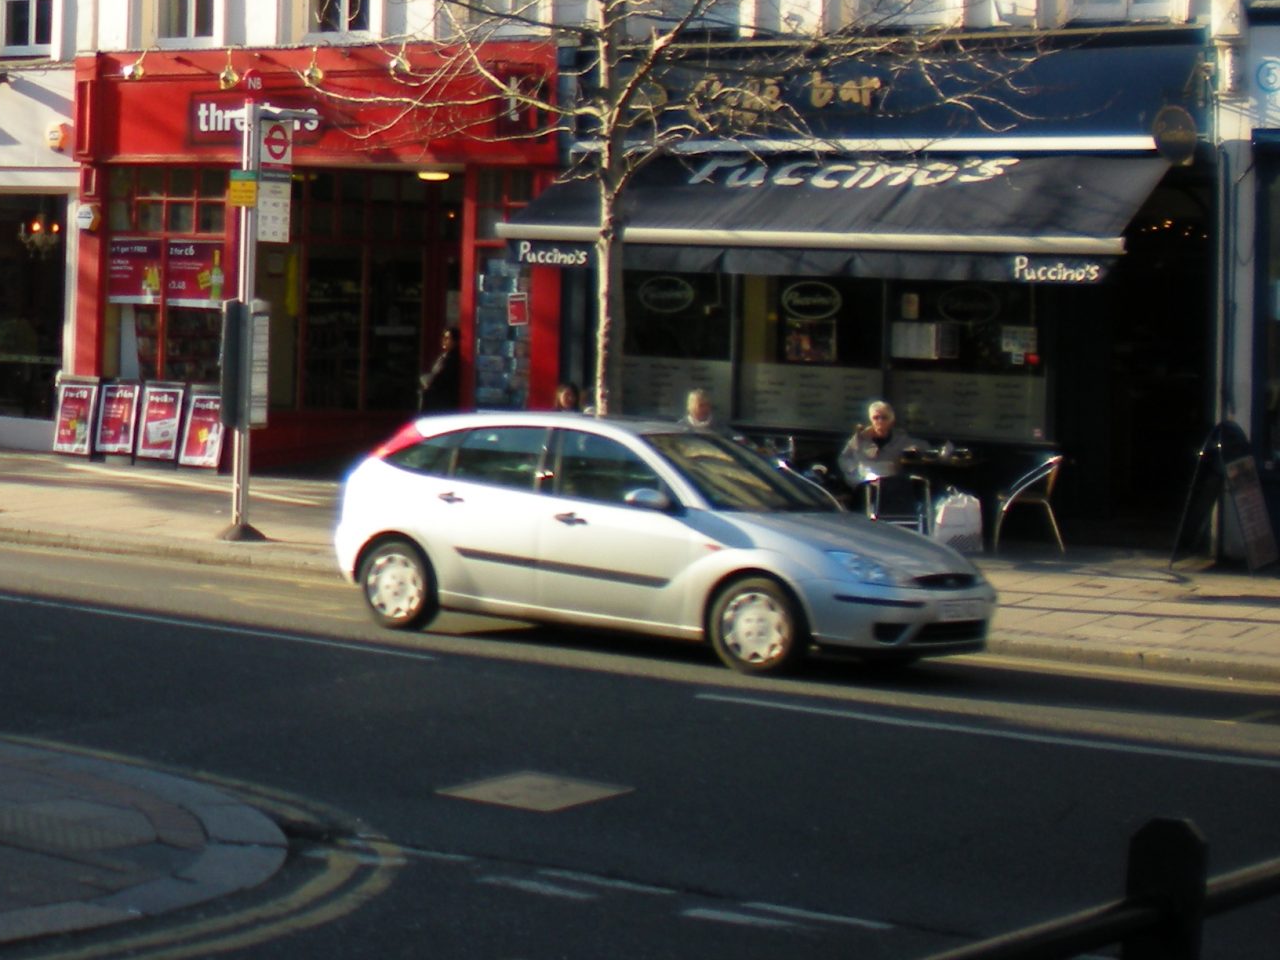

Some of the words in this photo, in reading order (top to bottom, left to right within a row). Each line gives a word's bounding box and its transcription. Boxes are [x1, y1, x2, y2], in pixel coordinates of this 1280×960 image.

[811, 71, 881, 107] bar
[687, 157, 1020, 189] Puccino's
[518, 240, 588, 265] Puccino's
[1014, 255, 1100, 281] Puccino's
